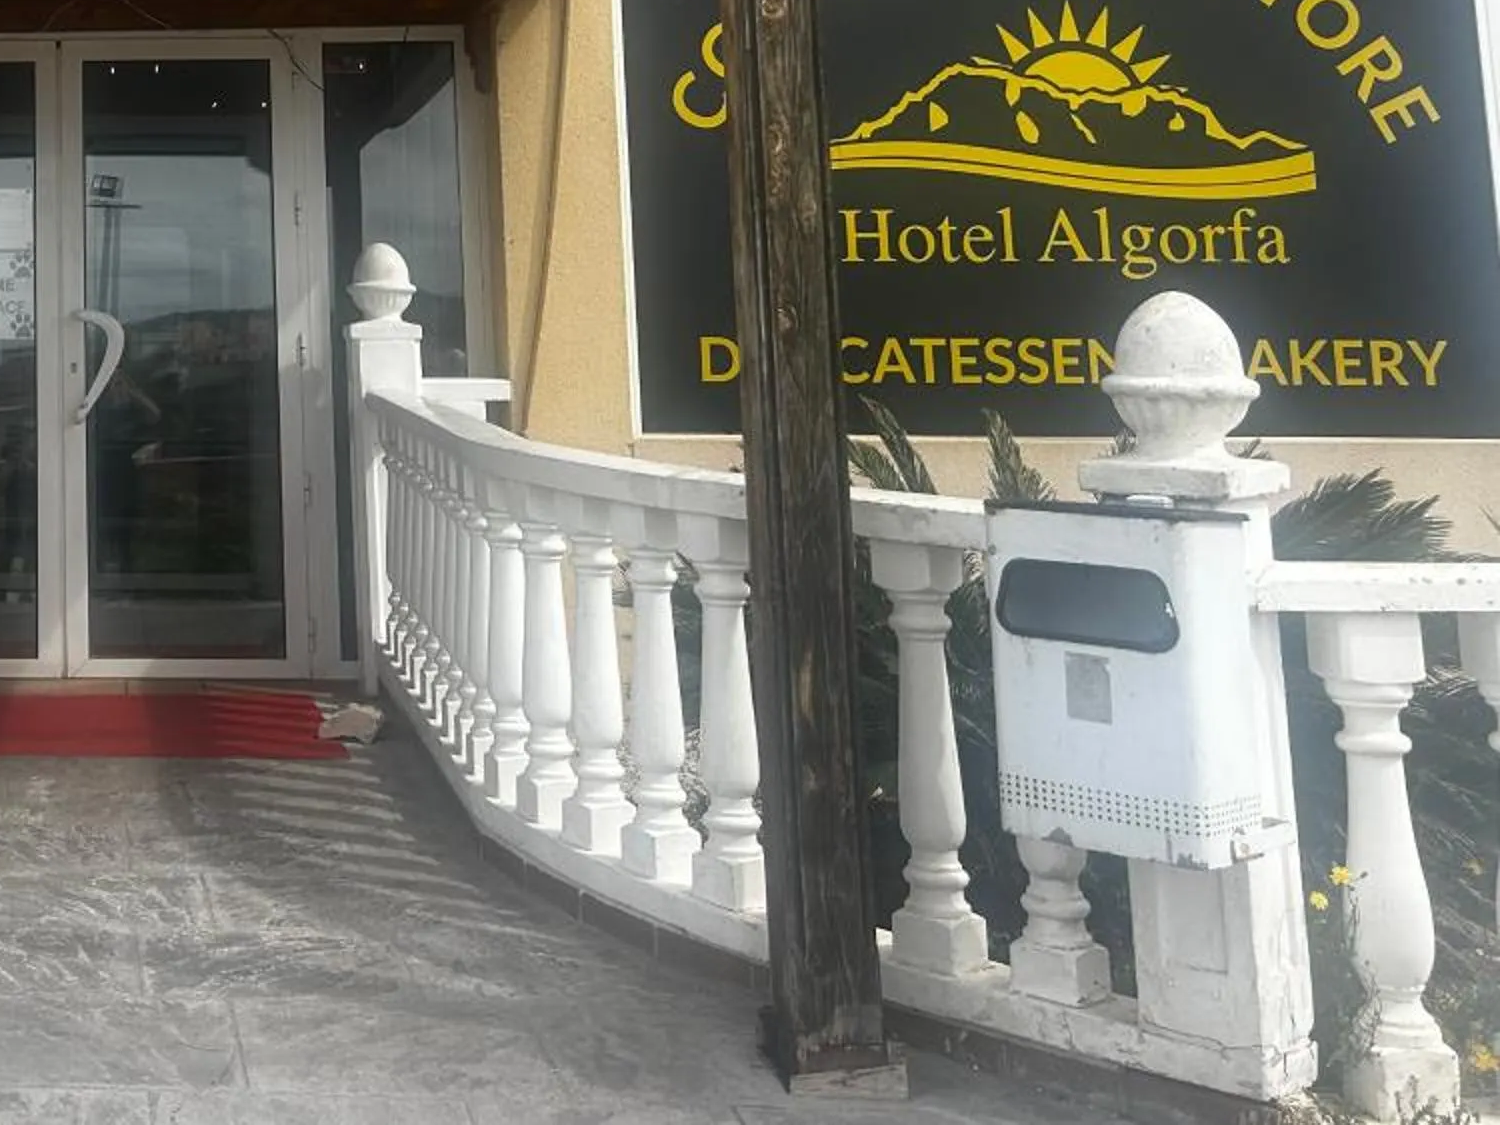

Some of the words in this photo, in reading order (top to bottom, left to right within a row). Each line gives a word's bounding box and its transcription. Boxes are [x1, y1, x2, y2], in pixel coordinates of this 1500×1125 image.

[840, 207, 1019, 264] Hotel
[1040, 207, 1291, 277] Algorfa
[699, 335, 1118, 386] DCATESSEN
[1245, 338, 1448, 387] AKERY
